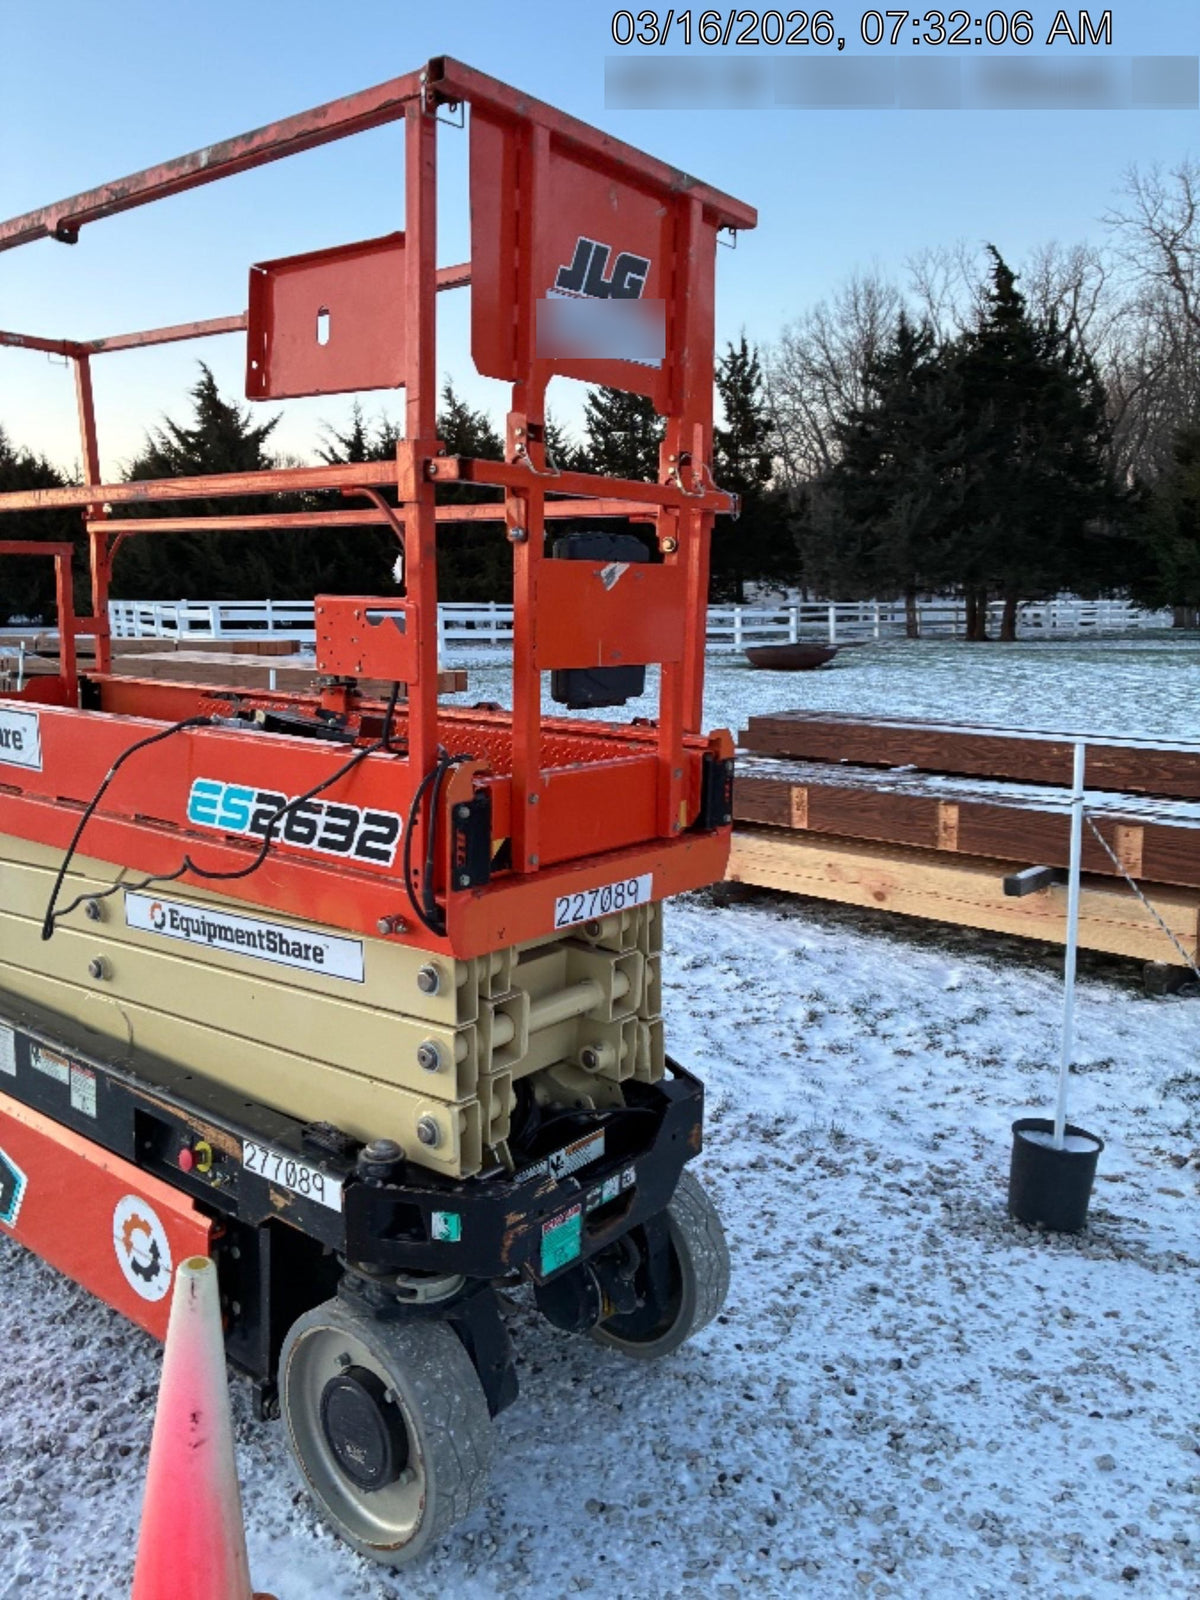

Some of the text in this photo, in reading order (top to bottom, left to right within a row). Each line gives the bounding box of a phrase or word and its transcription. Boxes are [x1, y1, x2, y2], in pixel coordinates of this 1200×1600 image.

[555, 236, 650, 299] JLG
[187, 777, 402, 867] ES2632
[556, 879, 639, 926] 227089
[168, 908, 324, 964] EquipmentShare
[244, 1142, 325, 1202] 277089
